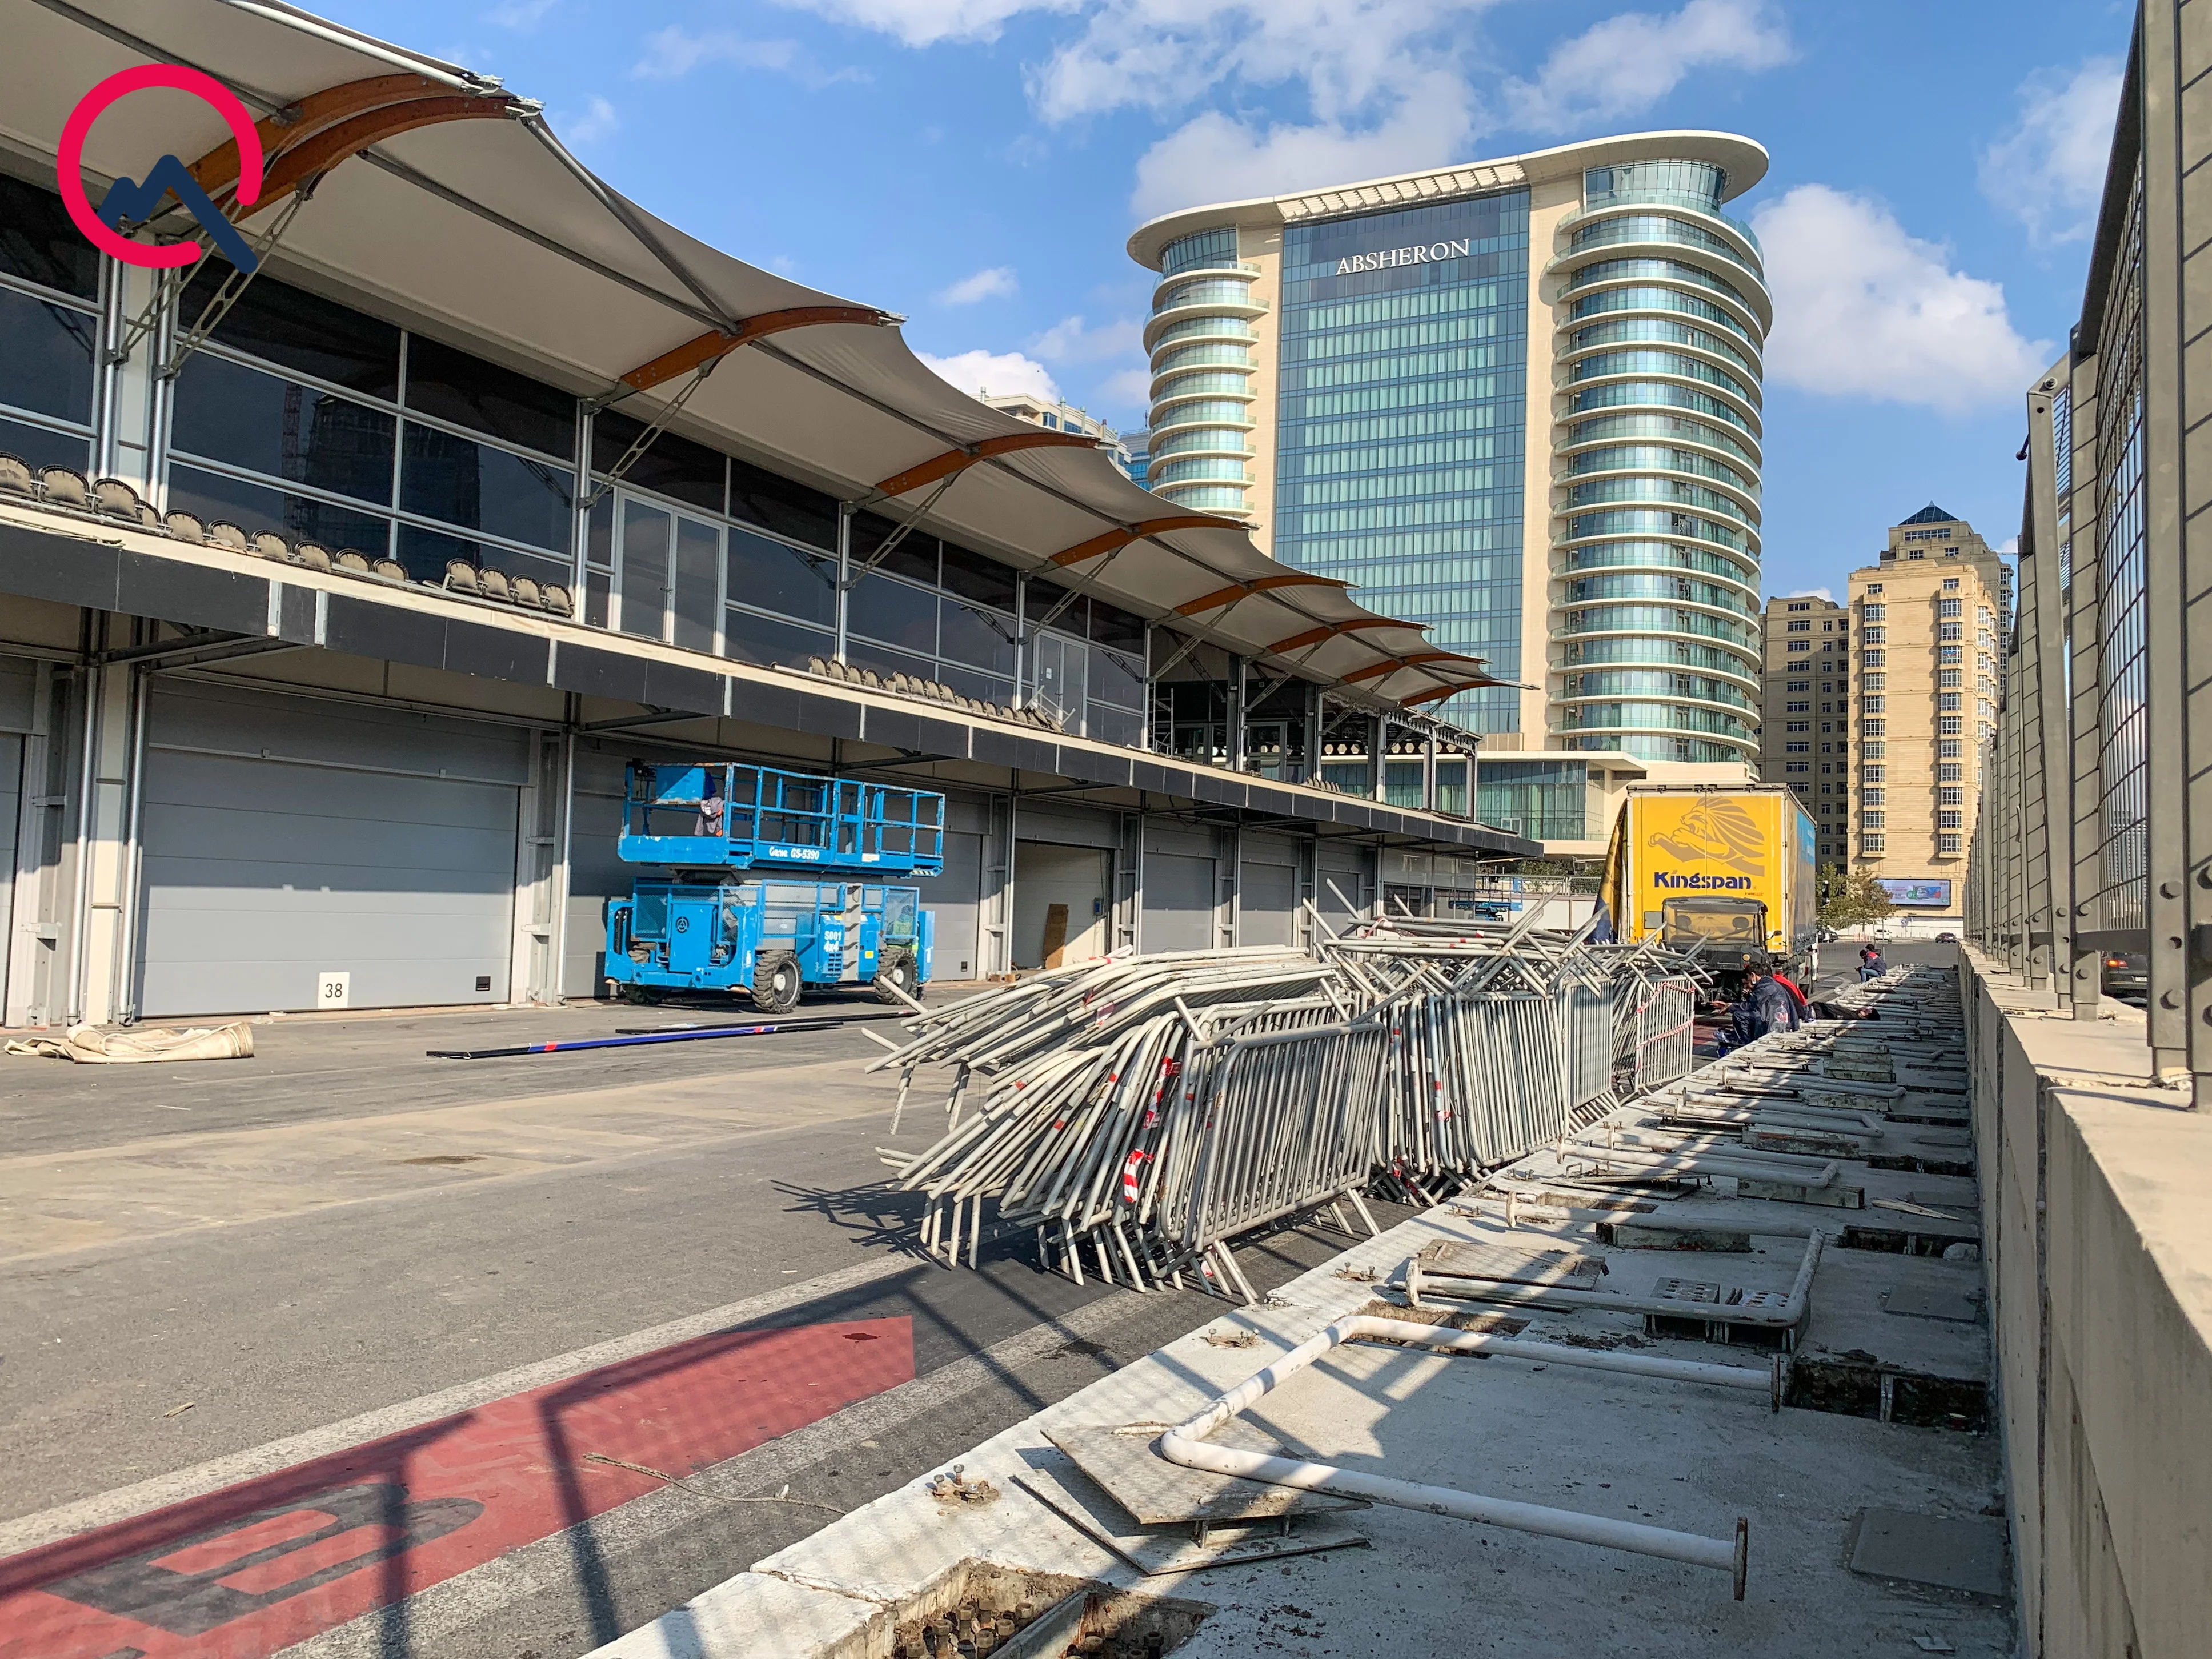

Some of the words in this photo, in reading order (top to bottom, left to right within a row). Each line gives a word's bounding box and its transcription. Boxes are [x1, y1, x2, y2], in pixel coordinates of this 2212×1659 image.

[1335, 238, 1470, 275] ABSHERON
[768, 846, 788, 857] Genie
[790, 848, 820, 860] GS-5390
[1654, 869, 1752, 889] Kingspan
[824, 931, 842, 941] S001
[823, 940, 839, 952] 4x4
[324, 983, 343, 999] 38
